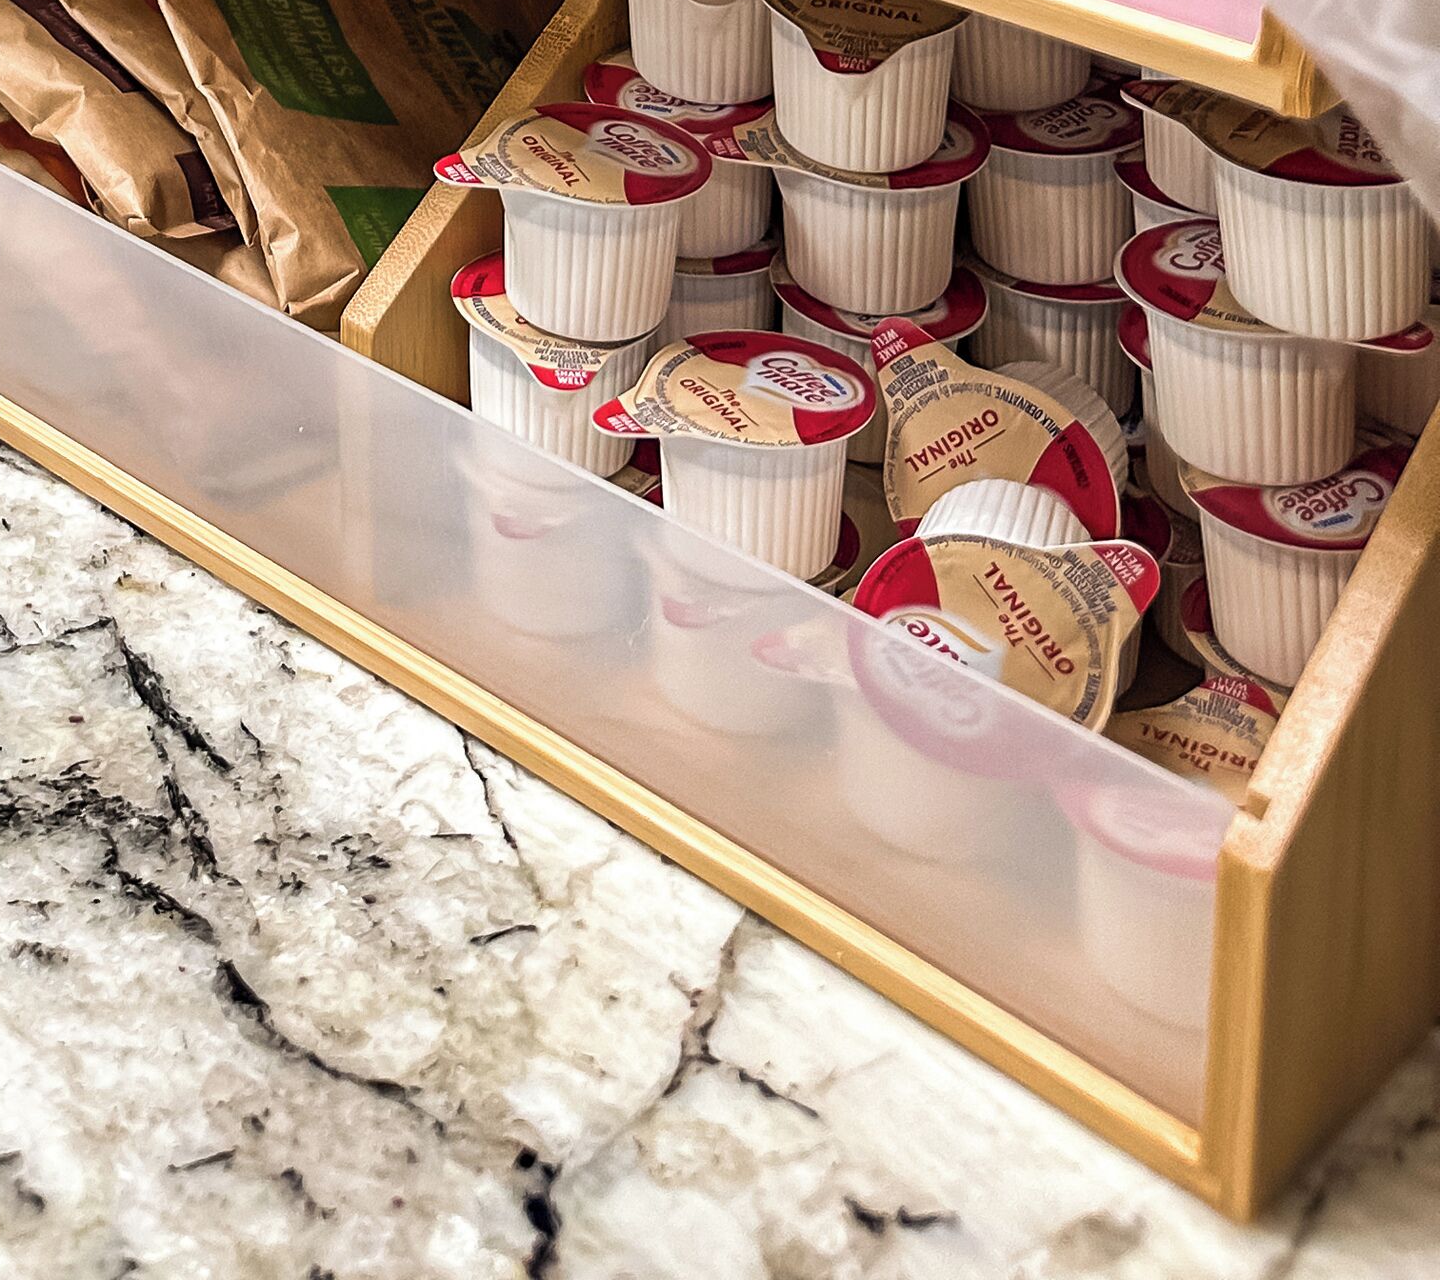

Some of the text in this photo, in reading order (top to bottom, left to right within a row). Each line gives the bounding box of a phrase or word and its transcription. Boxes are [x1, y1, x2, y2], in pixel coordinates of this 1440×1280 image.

[594, 137, 658, 169] mate
[603, 123, 673, 167] Coffee
[521, 135, 581, 188] ORIGINAL
[871, 328, 899, 349] WELL
[876, 337, 909, 363] SHAKE
[554, 369, 588, 379] SHAKE
[556, 376, 586, 386] WELL
[755, 368, 826, 404] mate
[761, 357, 840, 398] Coffee
[679, 378, 748, 433] ORIGINAL
[718, 388, 742, 408] The
[606, 415, 627, 433] WELL
[615, 412, 642, 433] SHAKE
[904, 408, 1000, 473] ORIGINAL
[949, 449, 977, 470] The
[1295, 477, 1385, 521] Coffee
[1102, 550, 1136, 586] SHAKE
[1113, 545, 1145, 577] WELL
[983, 560, 1074, 675] ORIGINAL
[998, 613, 1024, 648] The
[1178, 751, 1211, 772] The
